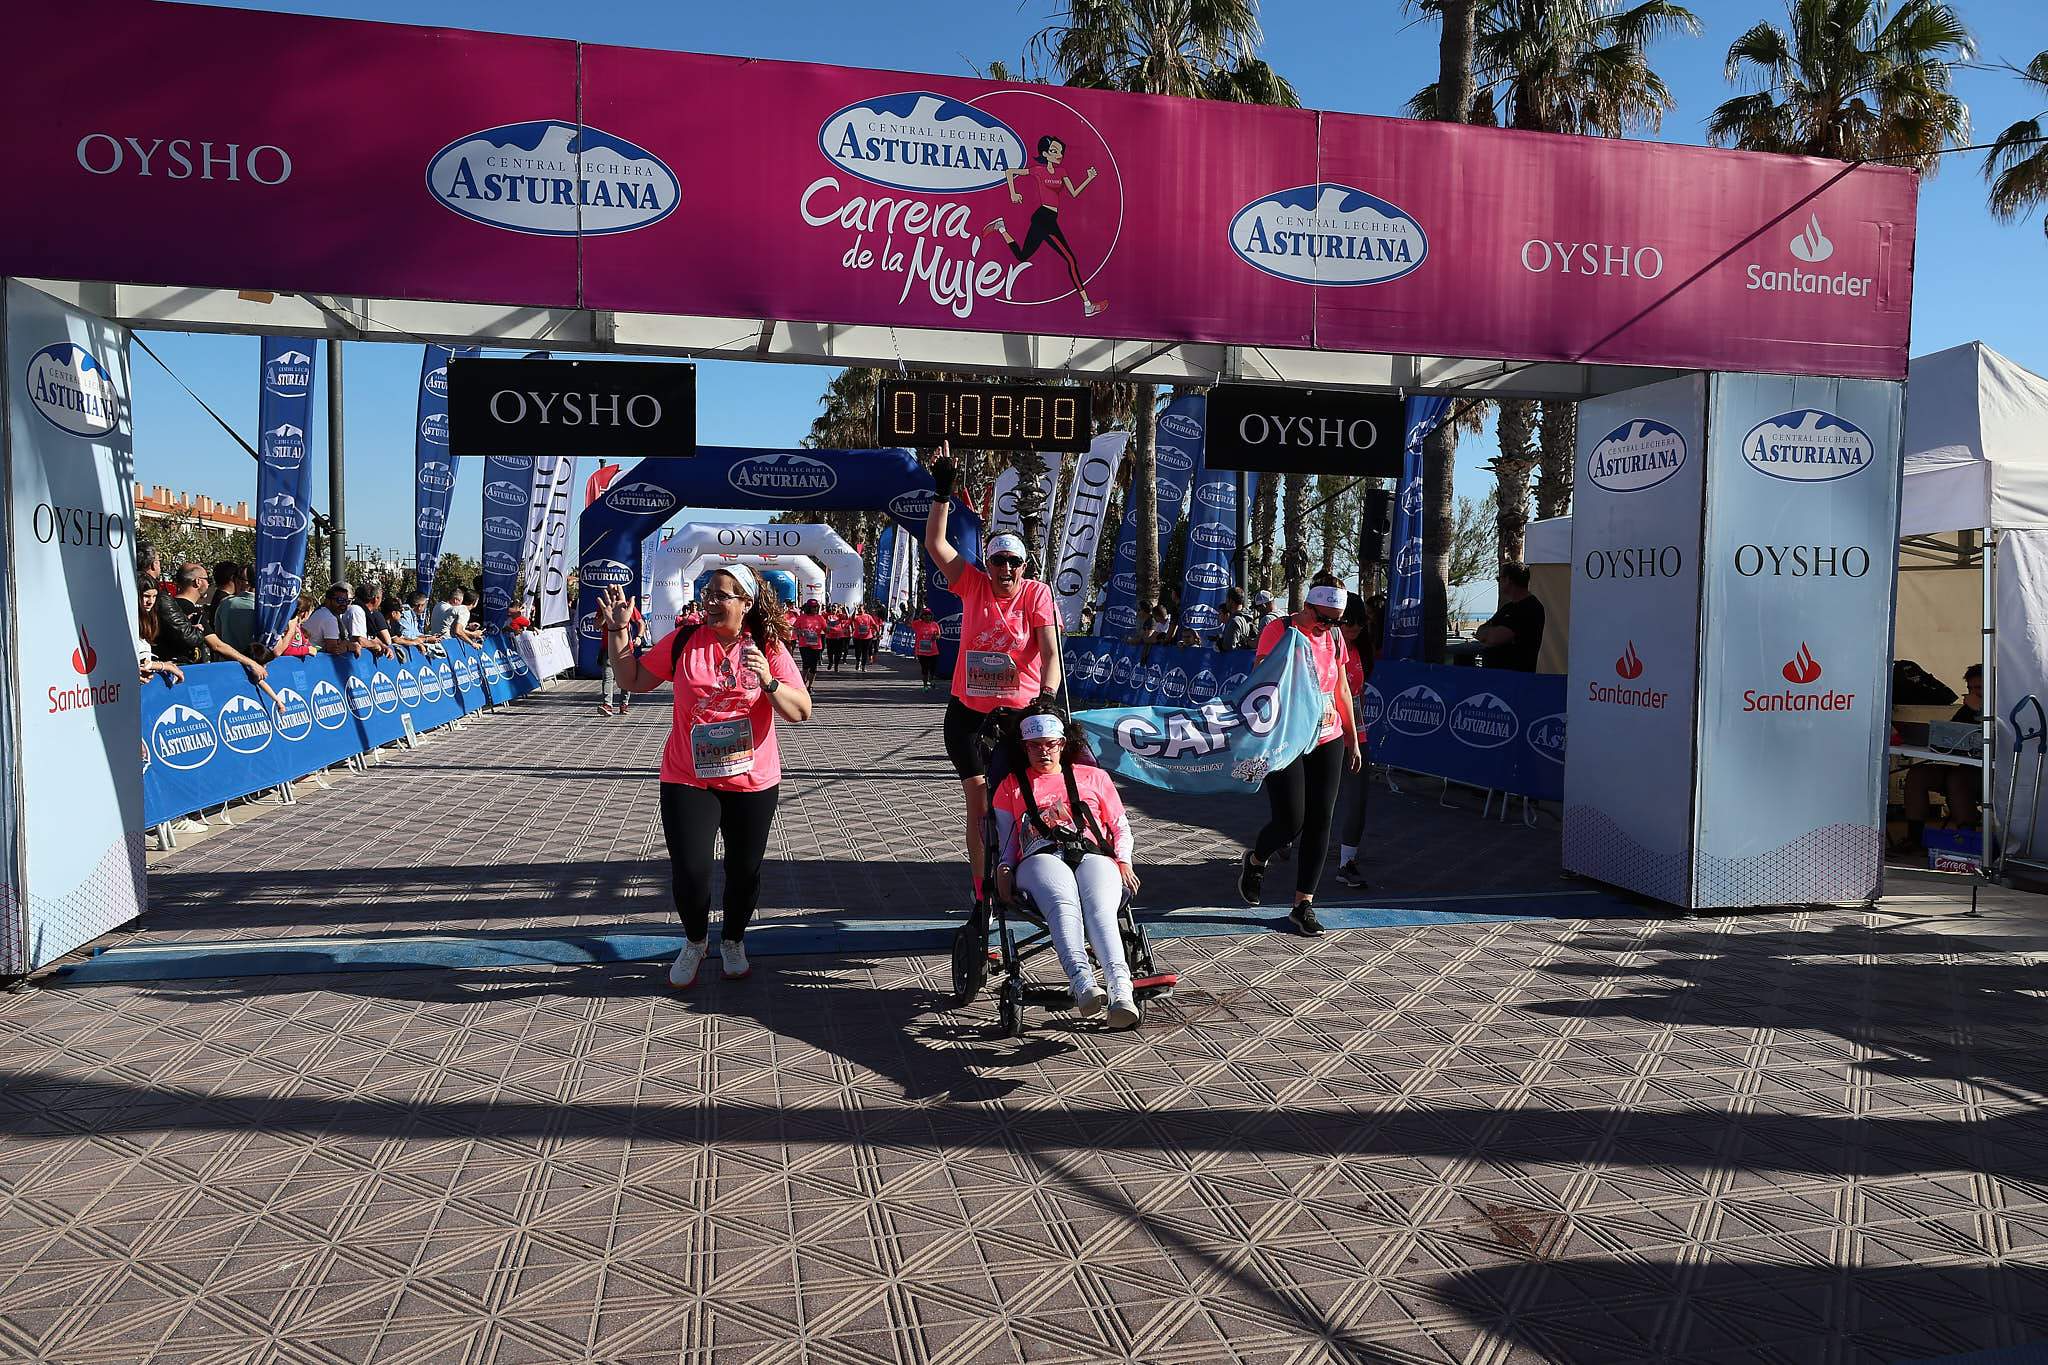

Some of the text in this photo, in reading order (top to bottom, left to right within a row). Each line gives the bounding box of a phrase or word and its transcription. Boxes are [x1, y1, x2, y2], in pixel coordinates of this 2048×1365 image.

[835, 121, 1009, 172] ASTURIANA
[868, 121, 1006, 143] CENTRAL LECHERA
[76, 133, 292, 185] OYSHO
[486, 156, 567, 172] CENTRAL
[446, 156, 662, 210] ASTURIANA
[800, 176, 971, 240] Carrera
[1276, 215, 1407, 233] CENTRAL LECHERA
[1244, 216, 1413, 263] ASTURIANA
[1520, 239, 1664, 280] OYSHO
[842, 234, 1033, 319] de la Mujer
[1745, 264, 1873, 297] Santander
[34, 366, 115, 421] ASTURIANA
[490, 389, 662, 428] OYSHO
[894, 391, 1076, 440] 01:08:08
[1163, 417, 1200, 437] ASTURIANA
[1239, 412, 1378, 450] OYSHO
[1772, 432, 1861, 444] CENTRAL LECHERA
[1156, 453, 1190, 468] STURIANA
[1608, 437, 1677, 455] CENTRAL LECHERA
[1750, 434, 1864, 466] ASTURIANA
[736, 465, 830, 488] ASTURIANA
[1593, 447, 1679, 479] ASTURIANA
[487, 484, 525, 504] ASTURIANA
[609, 492, 670, 508] ASTURIANA
[33, 503, 124, 550] OYSHO
[717, 529, 801, 547] OYSHO
[1056, 457, 1111, 597] OYSHO
[666, 546, 693, 554] OYSHO
[1585, 545, 1682, 580] OYSHO
[1734, 543, 1871, 579] OYSHO
[582, 567, 631, 583] ASTURIANA
[48, 679, 121, 713] Santander
[1588, 681, 1669, 710] Santander
[1742, 689, 1856, 713] Santander
[276, 709, 310, 731] ASTURIANA
[1117, 685, 1280, 758] CAFO
[1390, 702, 1441, 726] ASTURIANA
[1452, 710, 1510, 738] ASTURIANA
[165, 722, 208, 737] CENTRAL LECHERA
[223, 719, 271, 743] ASTURIANA
[158, 730, 215, 759] ASTURIANA
[1934, 858, 1967, 872] Carrera
